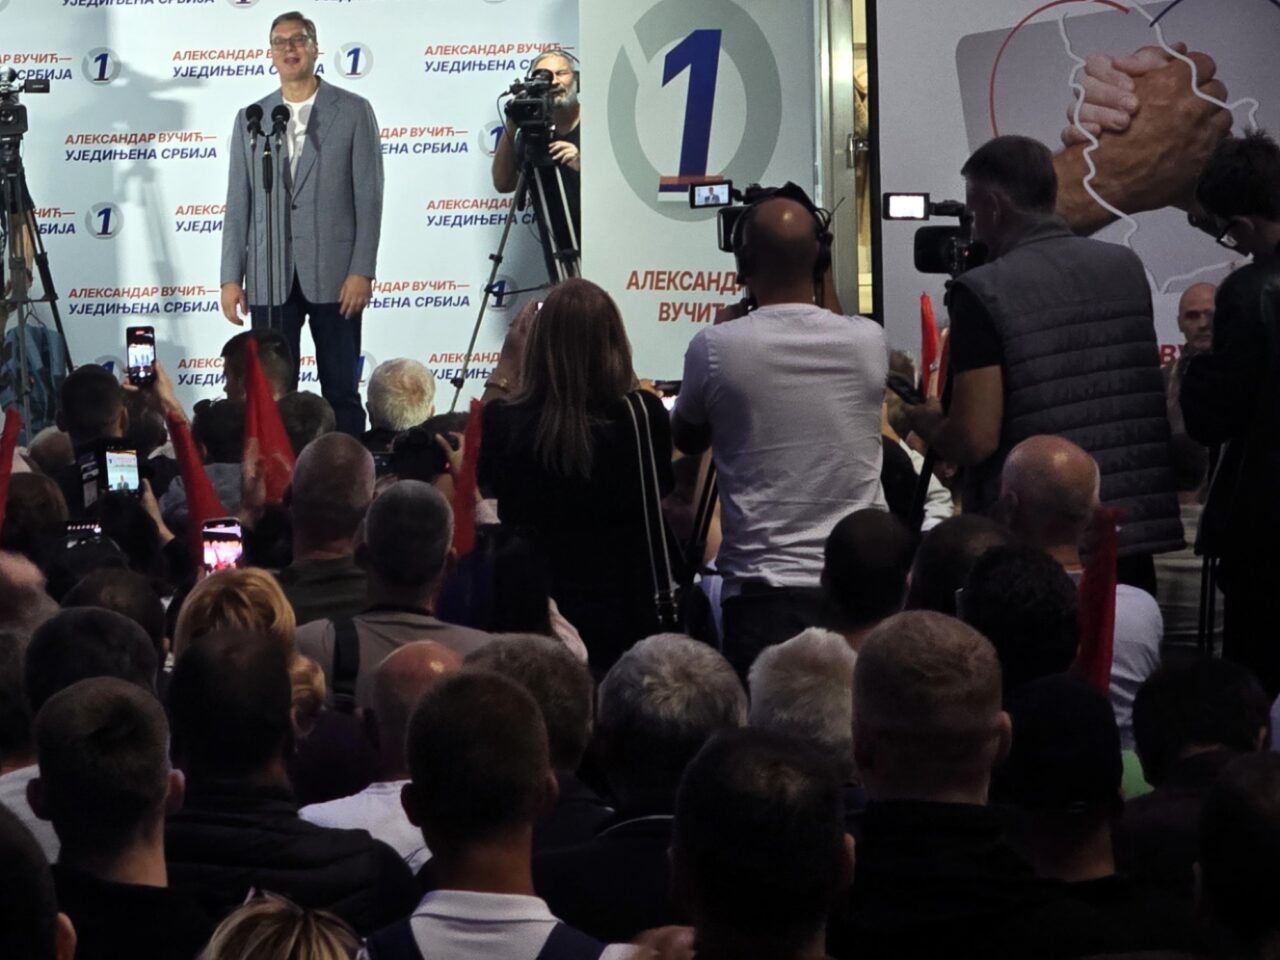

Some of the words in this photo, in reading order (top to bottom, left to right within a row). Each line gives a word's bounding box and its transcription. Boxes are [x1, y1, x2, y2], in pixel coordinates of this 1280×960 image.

[173, 49, 263, 61] АЛЕКСАНДАР
[424, 44, 515, 57] АЛЕКСАНДАР
[91, 52, 109, 82] 1
[346, 47, 362, 76] 1
[424, 60, 516, 73] УЈЕДИЊЕНА
[16, 68, 73, 81] СРБИЈА
[172, 65, 265, 78] УЈЕДИЊЕНА
[658, 28, 724, 195] 1
[65, 133, 156, 145] АЛЕКСАНДАР
[65, 149, 157, 162] УЈЕДИЊЕНА
[161, 147, 217, 160] СРБИЈА
[412, 142, 469, 154] СРБИЈА
[34, 207, 76, 219] ЧИЋ—
[175, 205, 227, 216] АЛЕКСА
[95, 207, 113, 237] 1
[175, 220, 224, 233] УЈЕДИ
[37, 223, 76, 235] БИЈА
[626, 270, 742, 296] АЛЕКСАНД
[69, 286, 160, 299] АЛЕКСАНДАР
[415, 295, 470, 307] СРБИЈА
[69, 302, 160, 316] УЈЕДИЊЕНА
[163, 301, 220, 313] СРБИЈА
[178, 357, 225, 369] АЛЕКС
[429, 351, 500, 364] АЛЕКАНД
[177, 373, 226, 386] УЈЕДИ
[432, 367, 496, 380] УЈЕДИЊ
